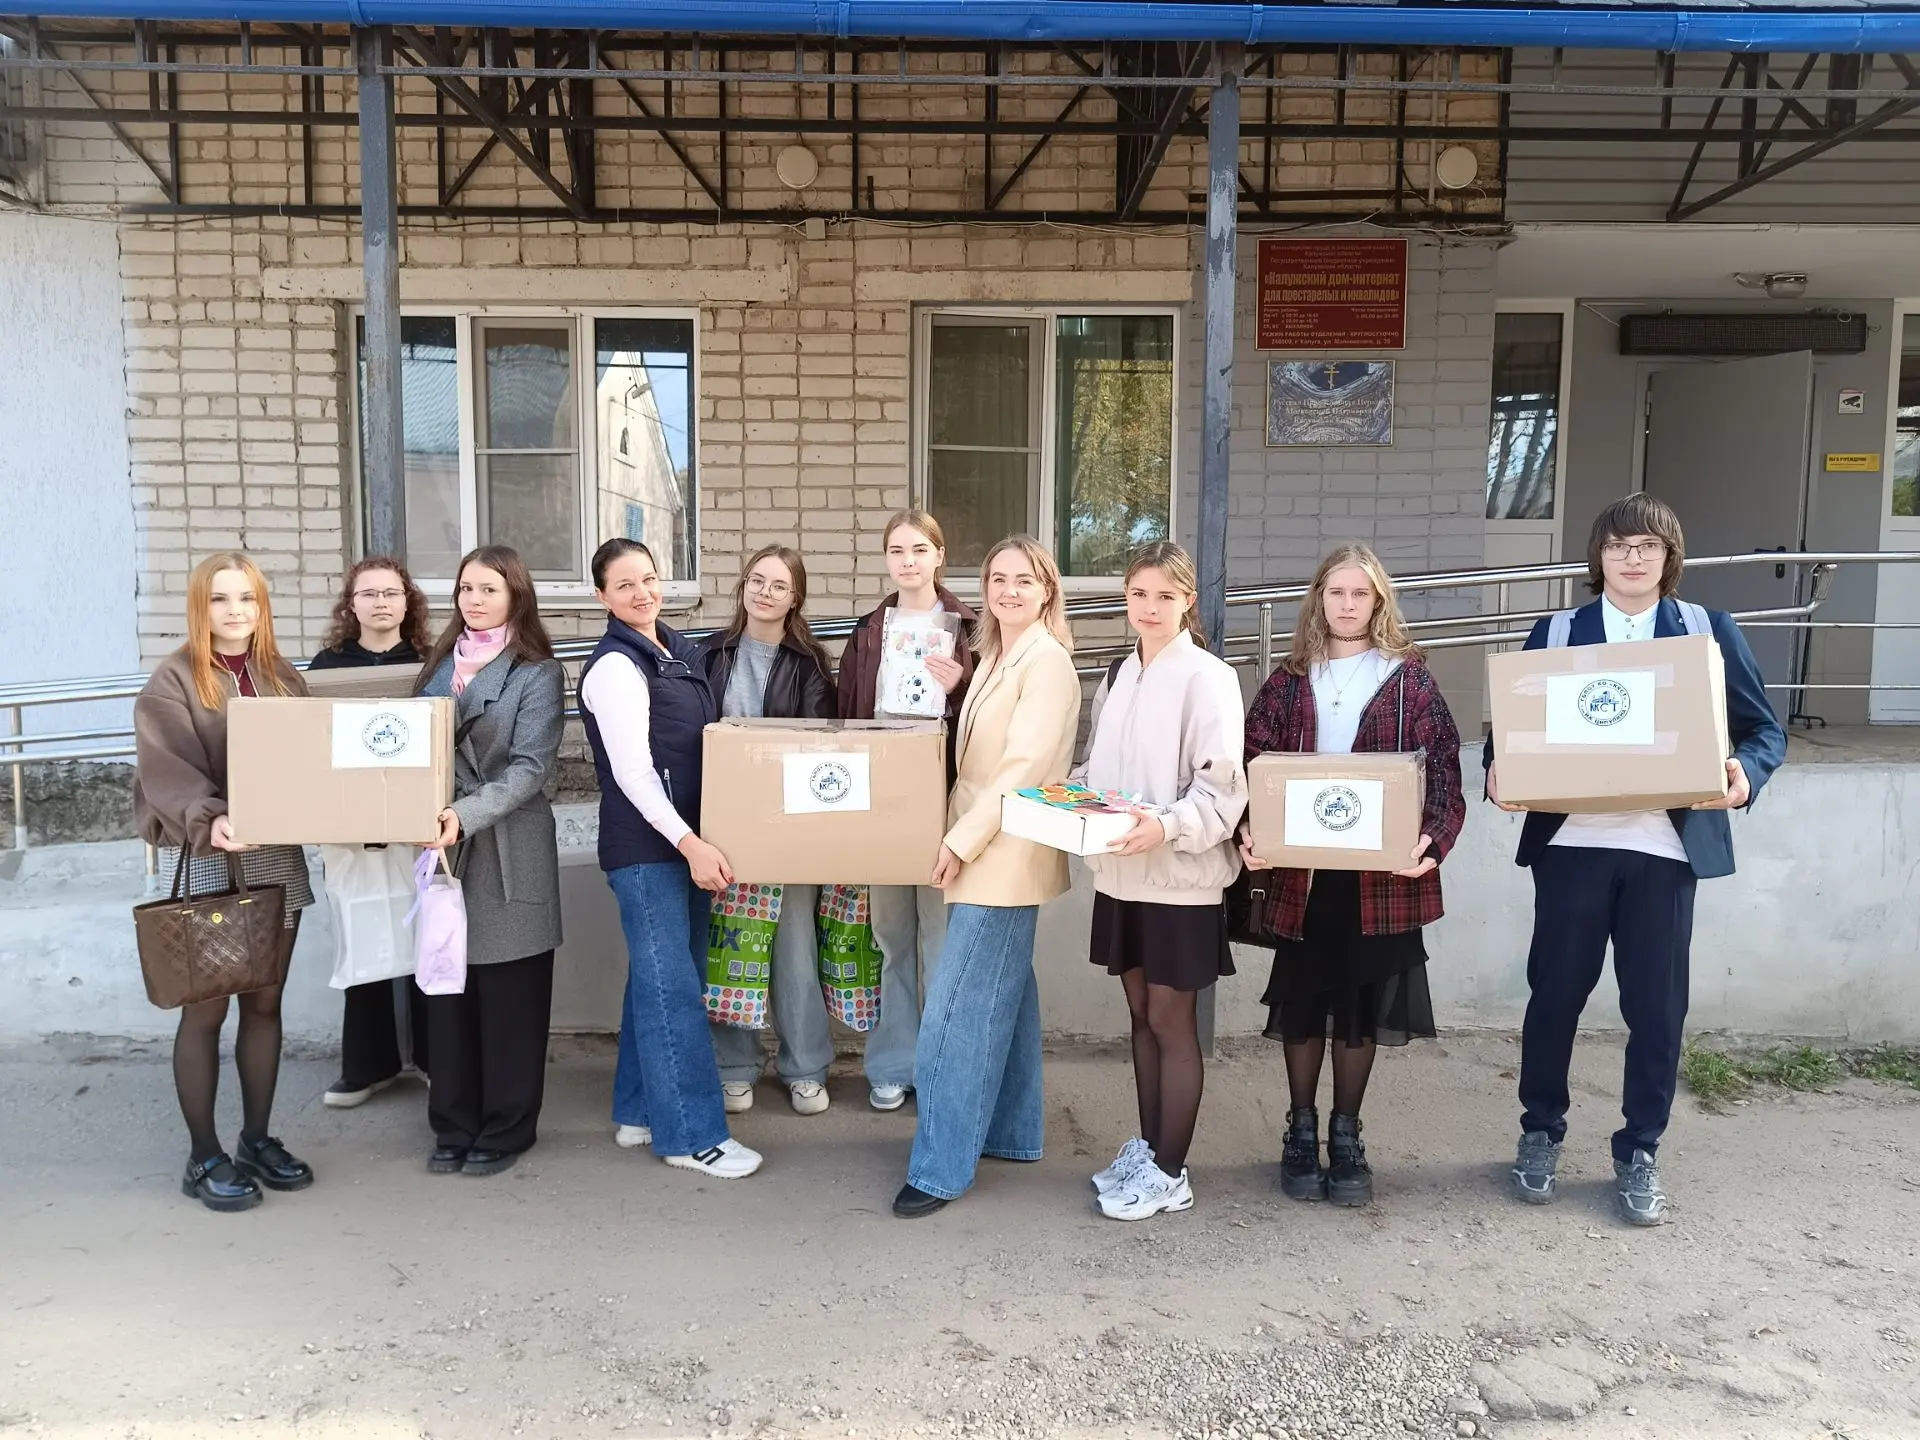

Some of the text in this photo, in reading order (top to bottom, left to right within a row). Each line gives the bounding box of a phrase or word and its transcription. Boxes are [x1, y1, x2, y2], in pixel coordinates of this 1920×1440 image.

[1328, 273, 1400, 287] дом-интернат
[1263, 289, 1281, 303] для
[1282, 289, 1340, 302] престарелых
[1340, 289, 1347, 301] и
